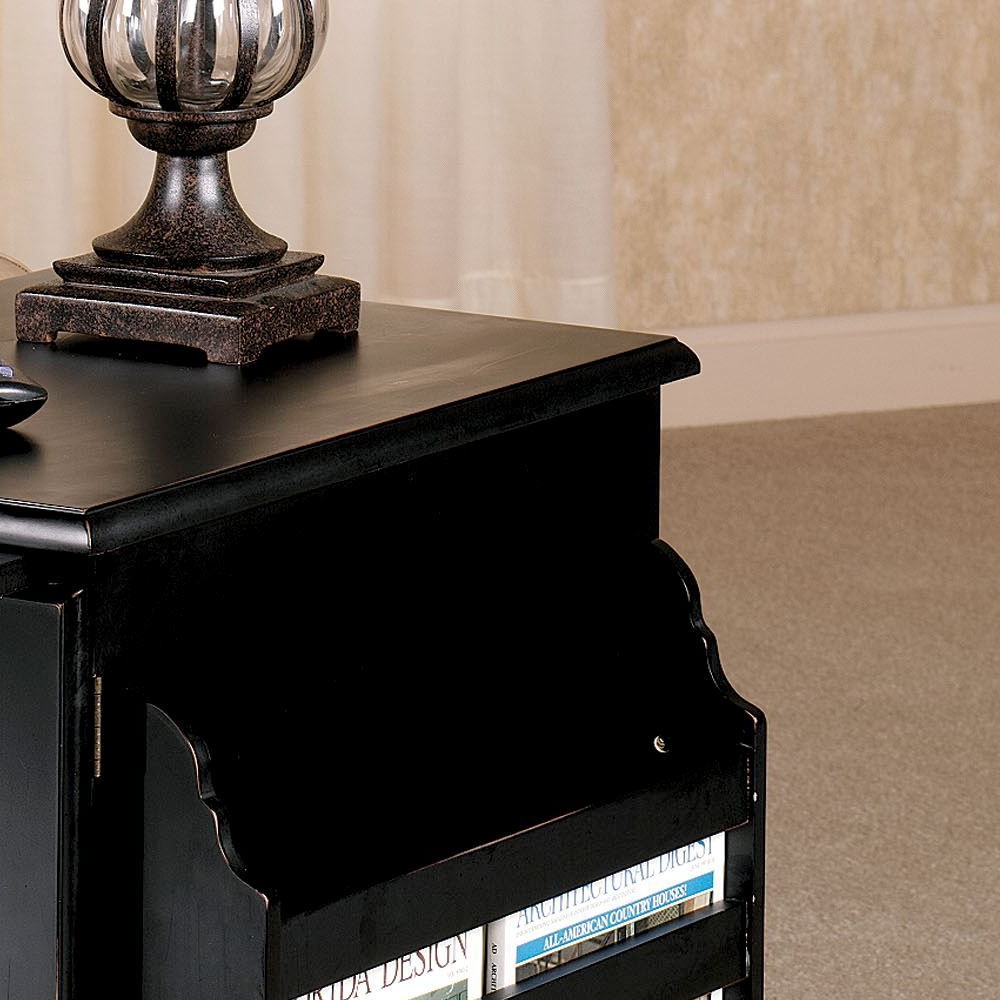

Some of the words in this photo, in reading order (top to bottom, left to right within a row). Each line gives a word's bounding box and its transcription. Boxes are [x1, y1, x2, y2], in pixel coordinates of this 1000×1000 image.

[517, 860, 655, 929] ARCHITECTURAL
[659, 836, 713, 873] DIGEST
[543, 914, 609, 950] ALL-AMERICAN
[609, 896, 652, 925] COUNTRY
[652, 884, 688, 909] HOUSES!
[381, 932, 467, 989] DESIGN
